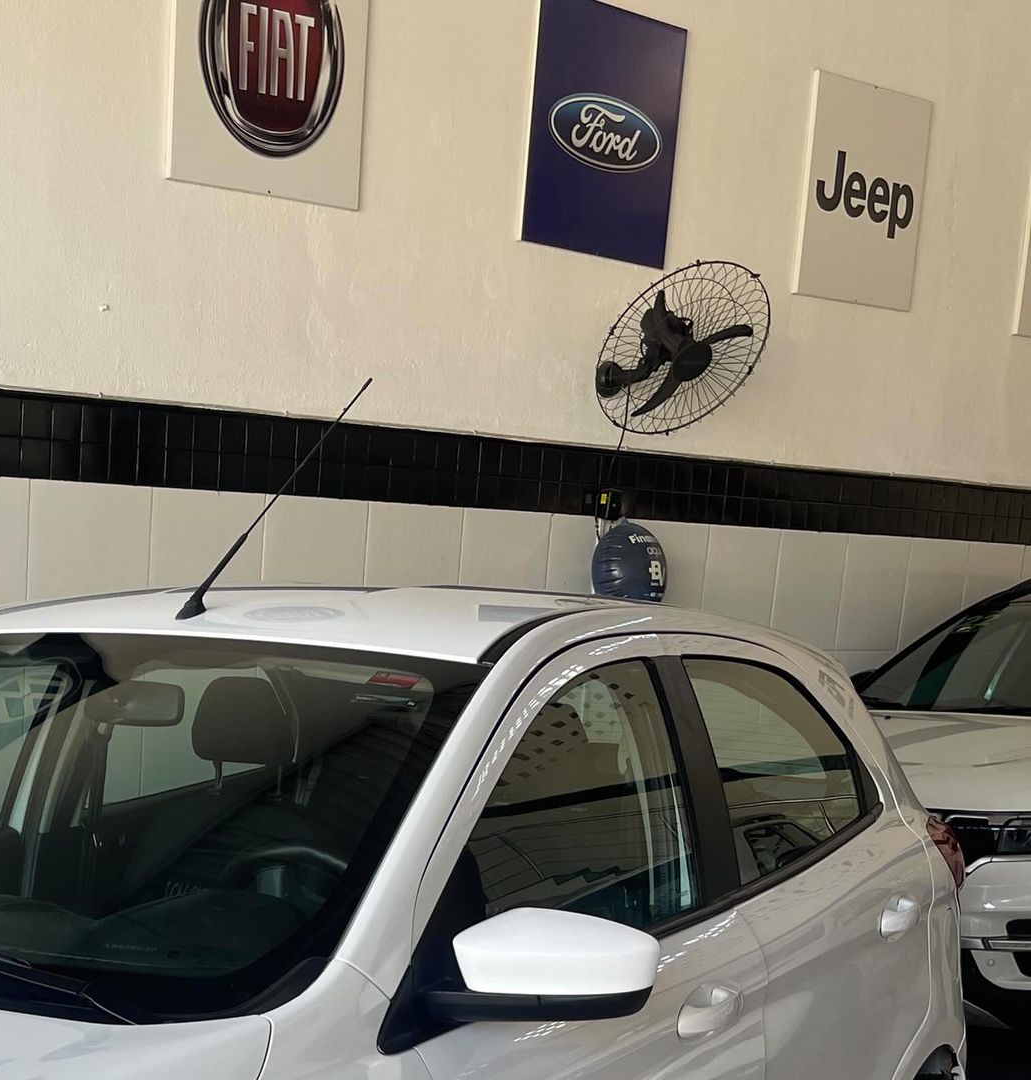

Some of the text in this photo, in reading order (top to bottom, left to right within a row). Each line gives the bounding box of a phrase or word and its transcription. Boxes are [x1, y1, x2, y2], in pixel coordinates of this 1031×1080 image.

[238, 2, 315, 101] FIAT
[571, 103, 642, 161] Ford
[816, 150, 914, 239] Jeep
